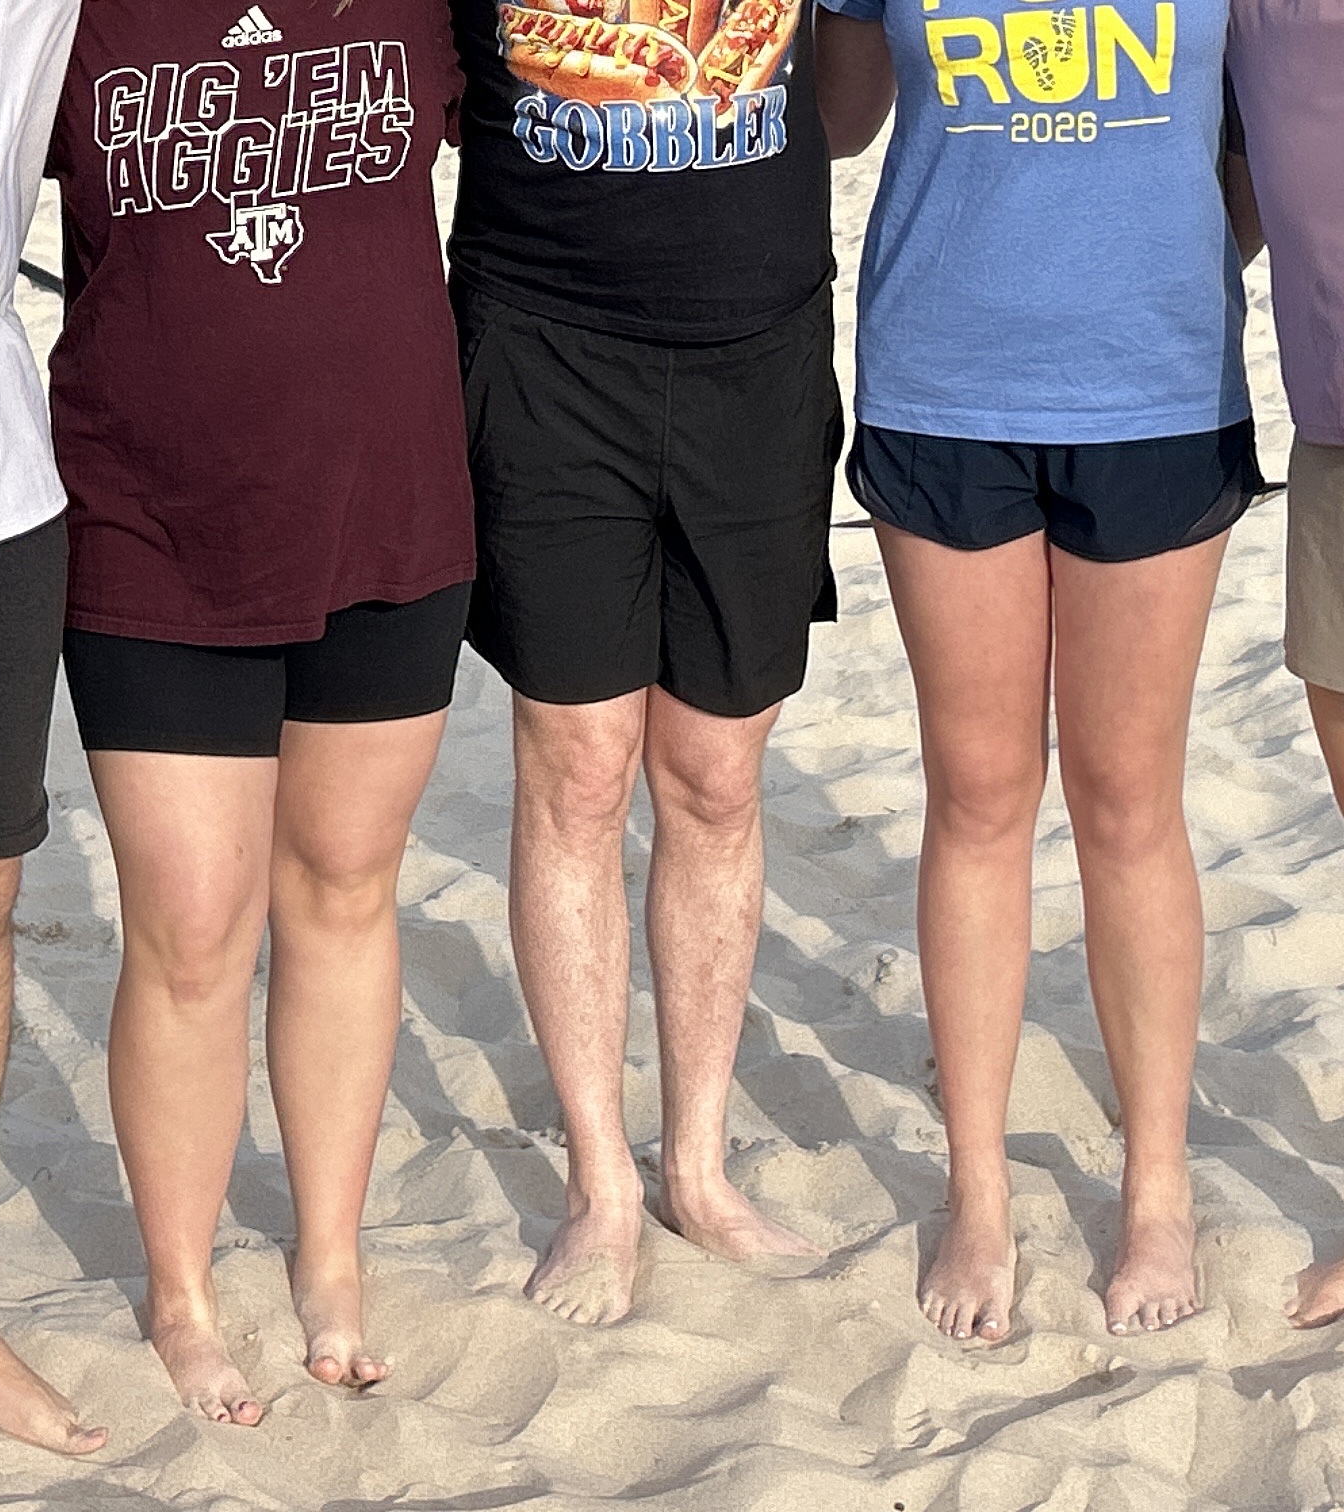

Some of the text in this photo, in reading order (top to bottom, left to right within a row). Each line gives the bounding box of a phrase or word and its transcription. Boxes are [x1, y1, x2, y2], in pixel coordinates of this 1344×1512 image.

[220, 29, 283, 49] adidas
[924, 1, 1176, 107] RUN
[94, 41, 410, 151] GIG 'EM
[513, 84, 790, 174] GOBBLER
[1010, 111, 1099, 144] 2026
[106, 97, 416, 217] AGGIES
